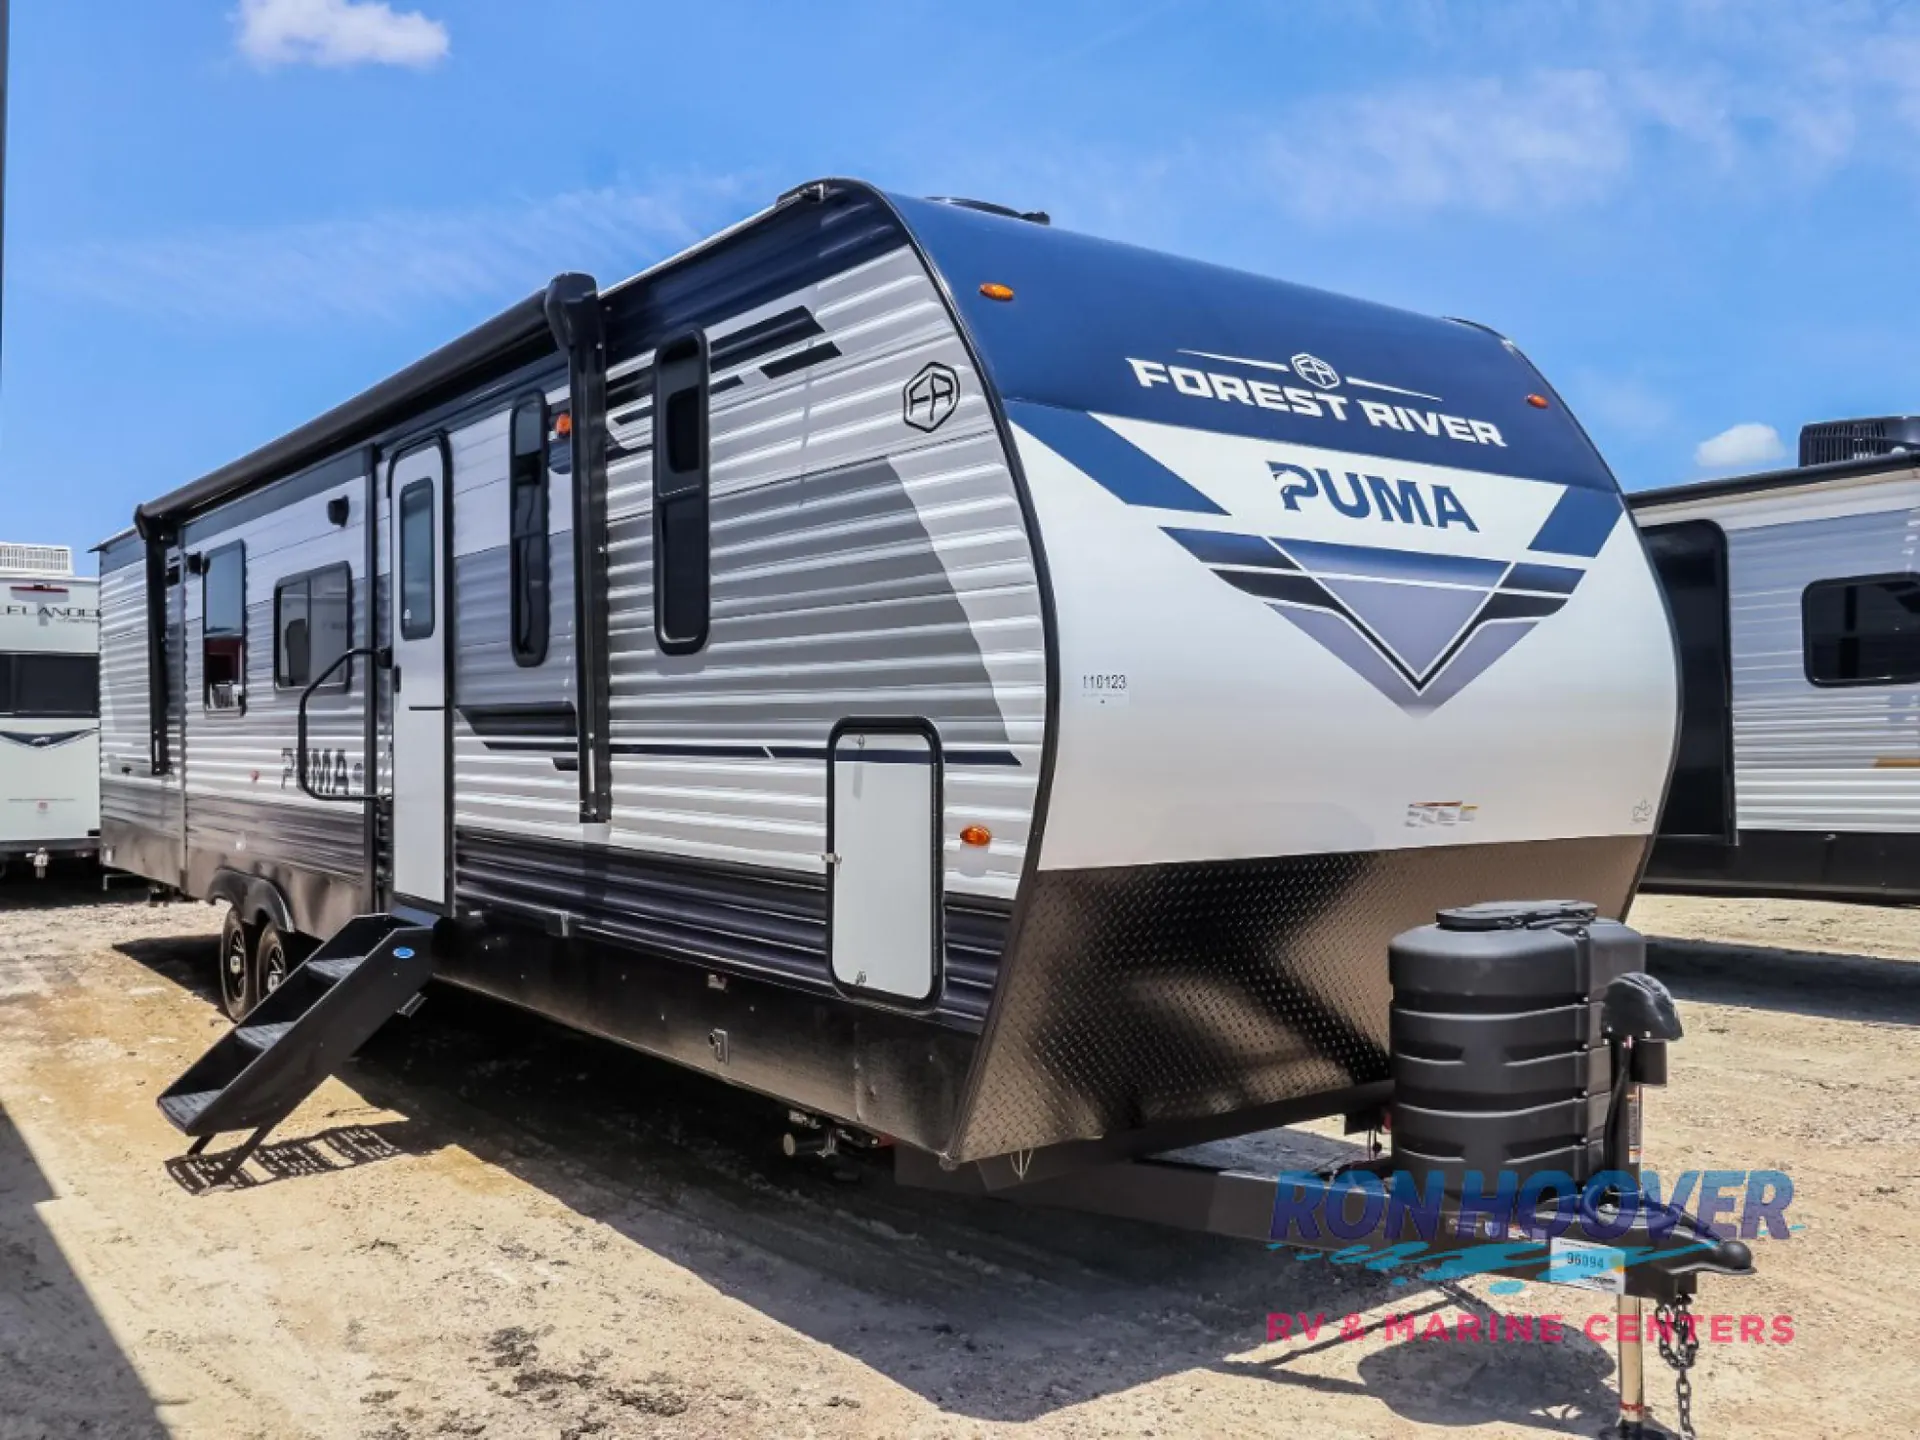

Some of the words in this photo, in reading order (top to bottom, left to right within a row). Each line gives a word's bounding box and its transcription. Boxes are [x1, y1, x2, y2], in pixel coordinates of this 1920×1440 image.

[1126, 357, 1348, 421] FOREST
[1357, 399, 1507, 447] RIVER
[1266, 460, 1480, 533] PUMA
